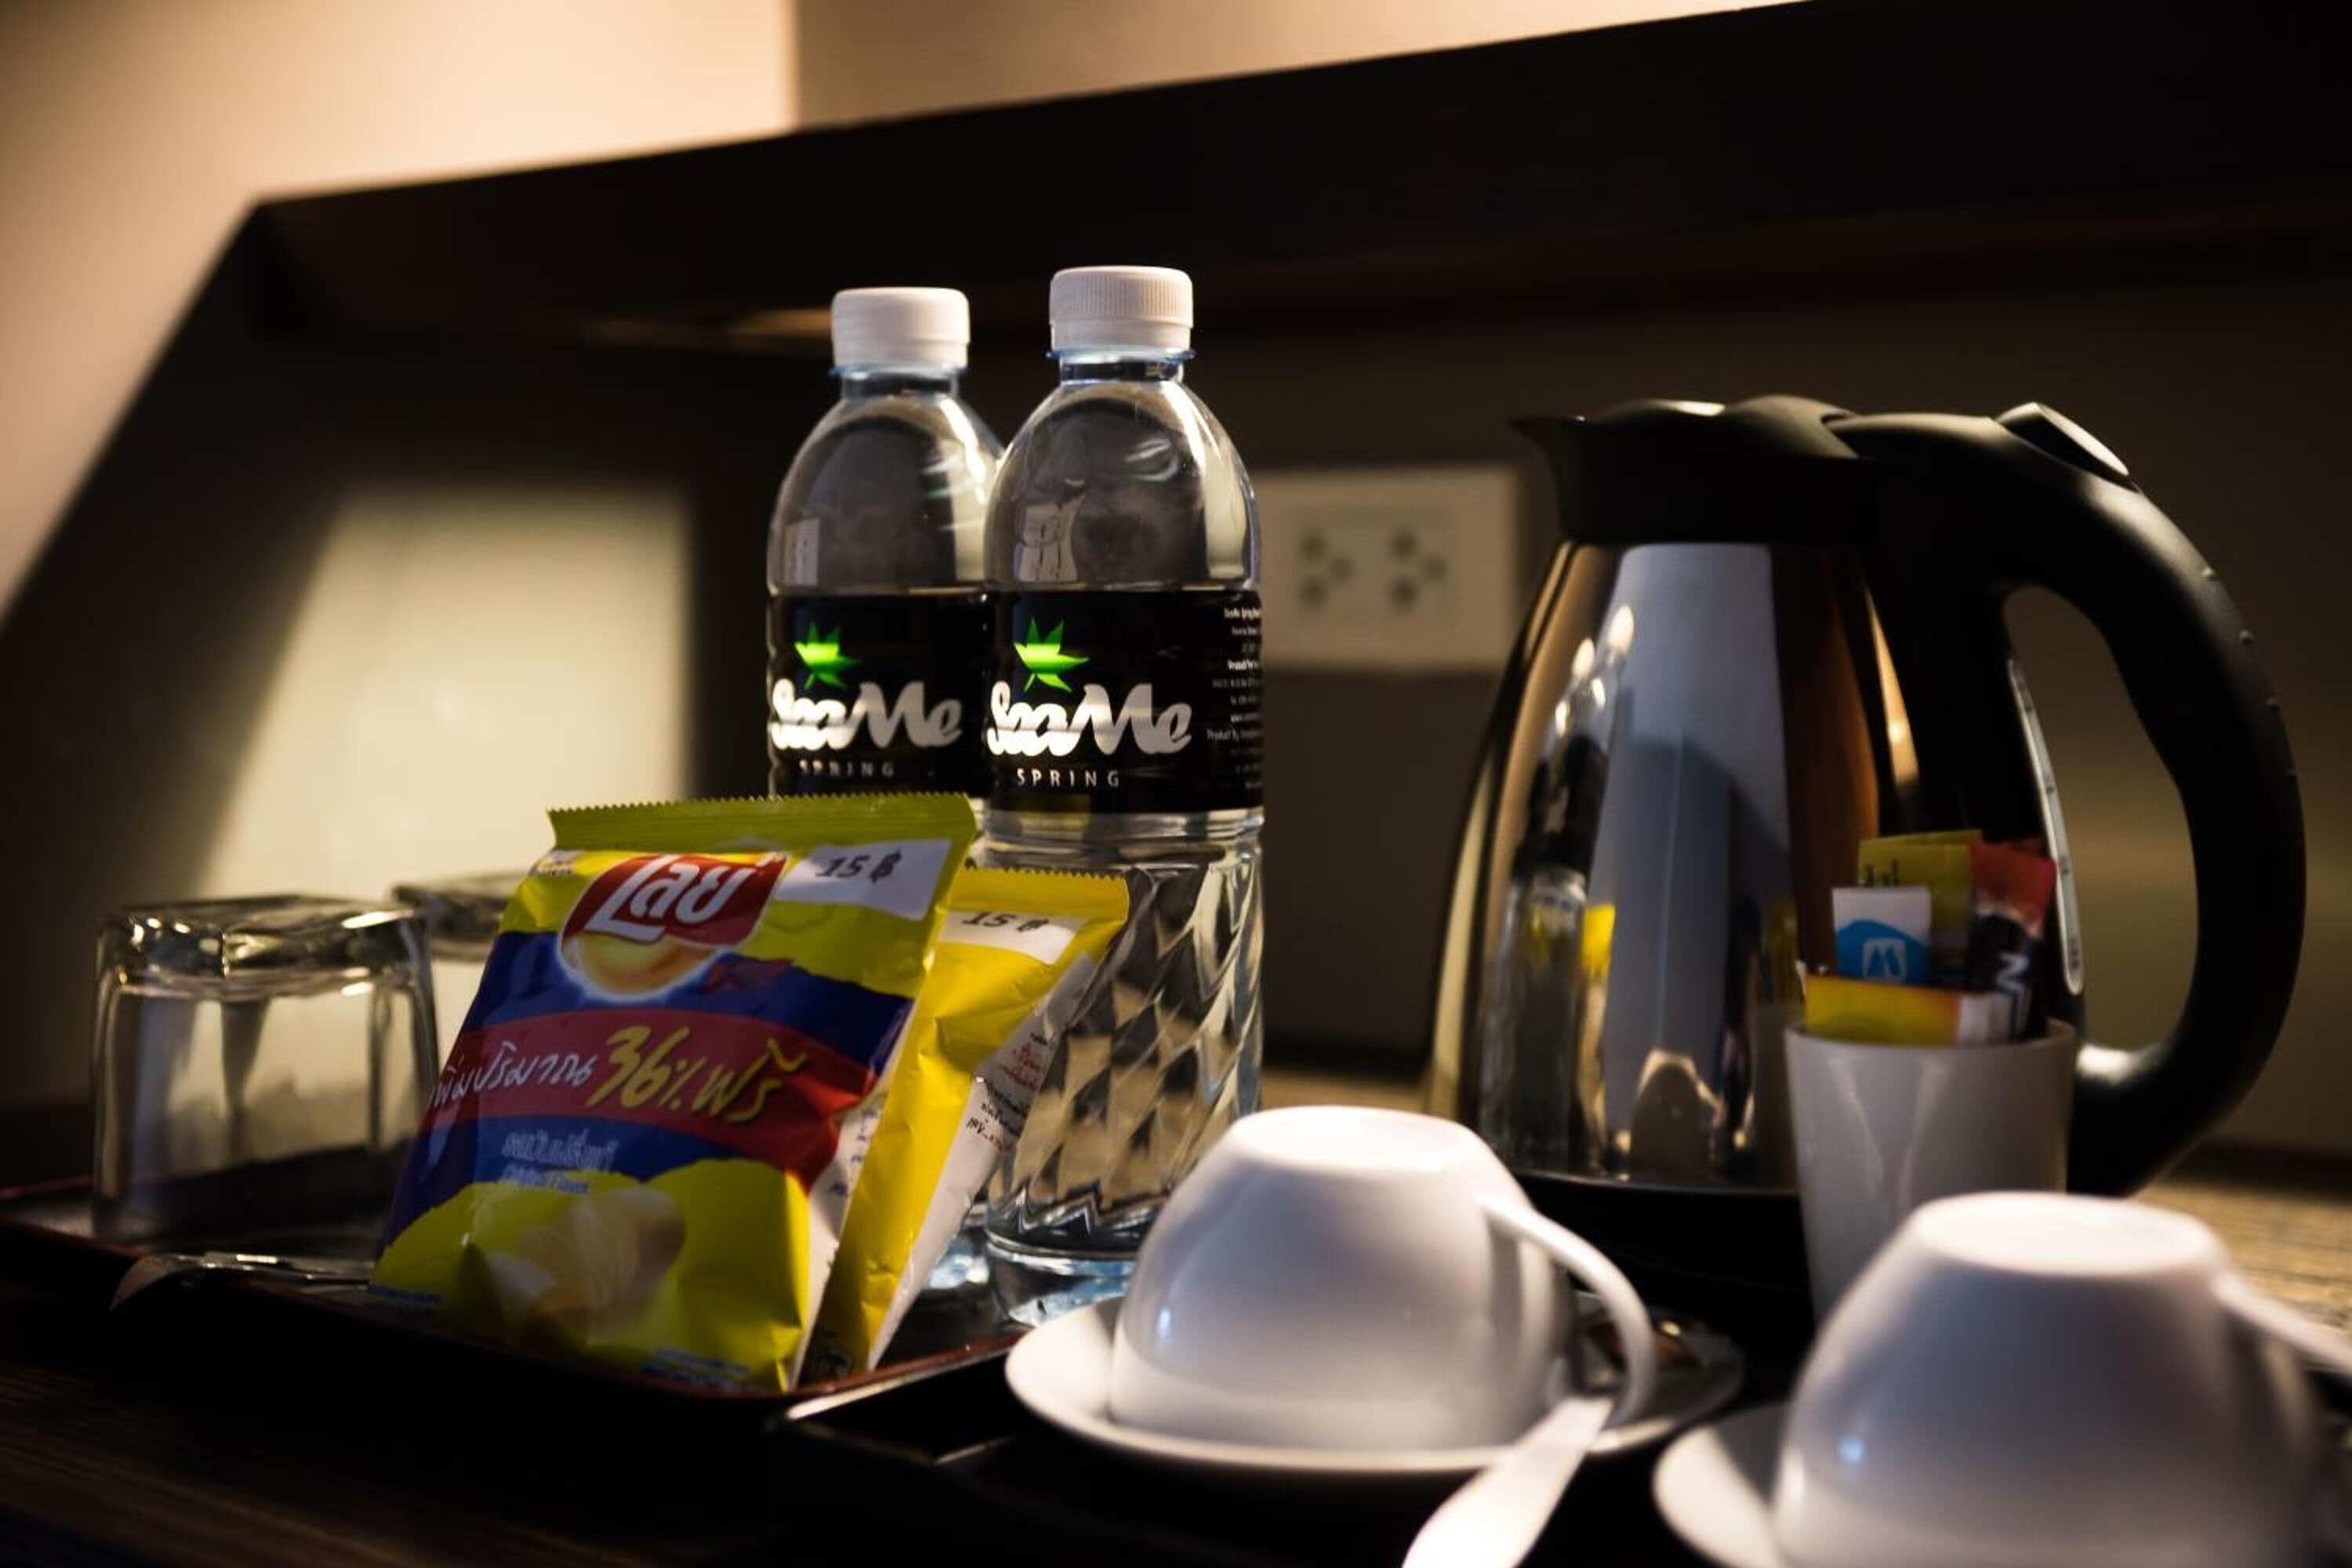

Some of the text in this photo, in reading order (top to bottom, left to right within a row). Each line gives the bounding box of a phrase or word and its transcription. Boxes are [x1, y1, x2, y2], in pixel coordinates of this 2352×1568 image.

[799, 760, 894, 777] SPRING
[1017, 768, 1119, 787] SPRING
[816, 855, 871, 877] 15
[962, 913, 1018, 927] 15
